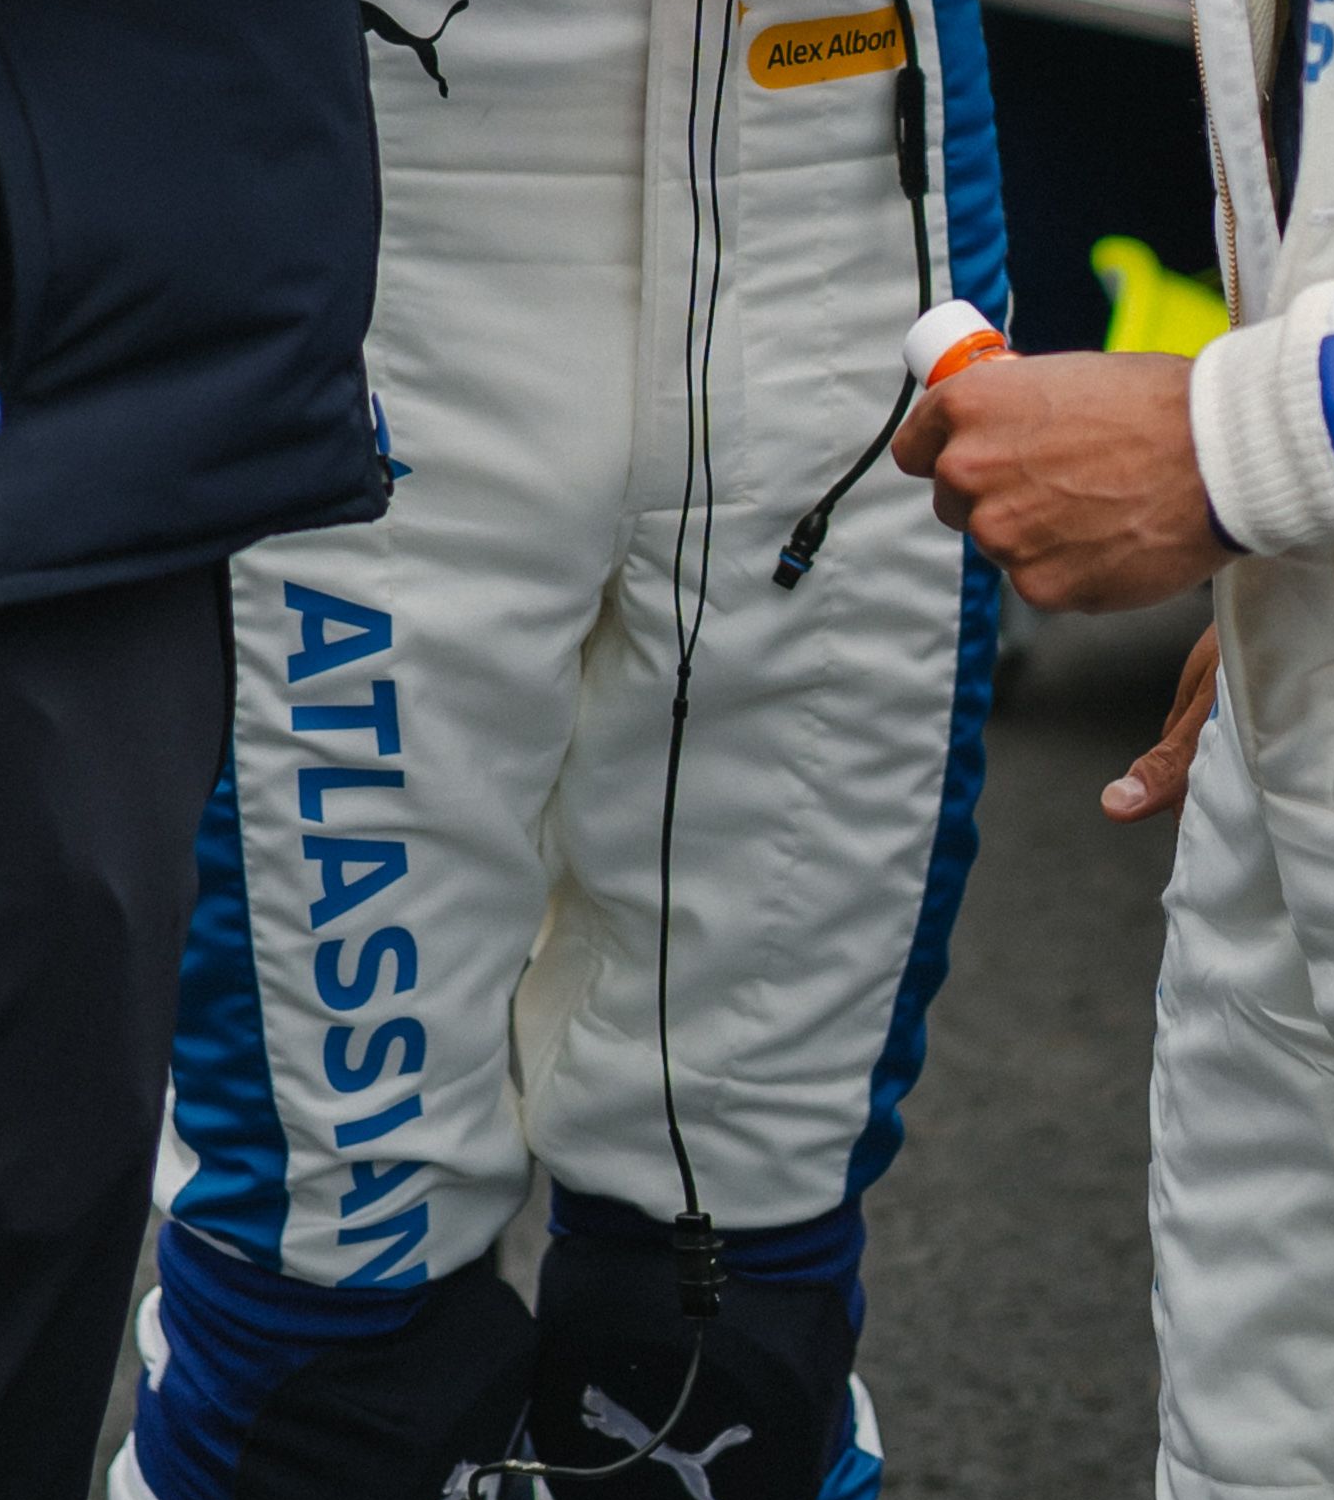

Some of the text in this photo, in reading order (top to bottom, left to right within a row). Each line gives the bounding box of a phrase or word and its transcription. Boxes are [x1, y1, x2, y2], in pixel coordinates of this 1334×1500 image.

[766, 26, 898, 70] Alex Albon
[282, 578, 430, 1289] ATLASSIAN
